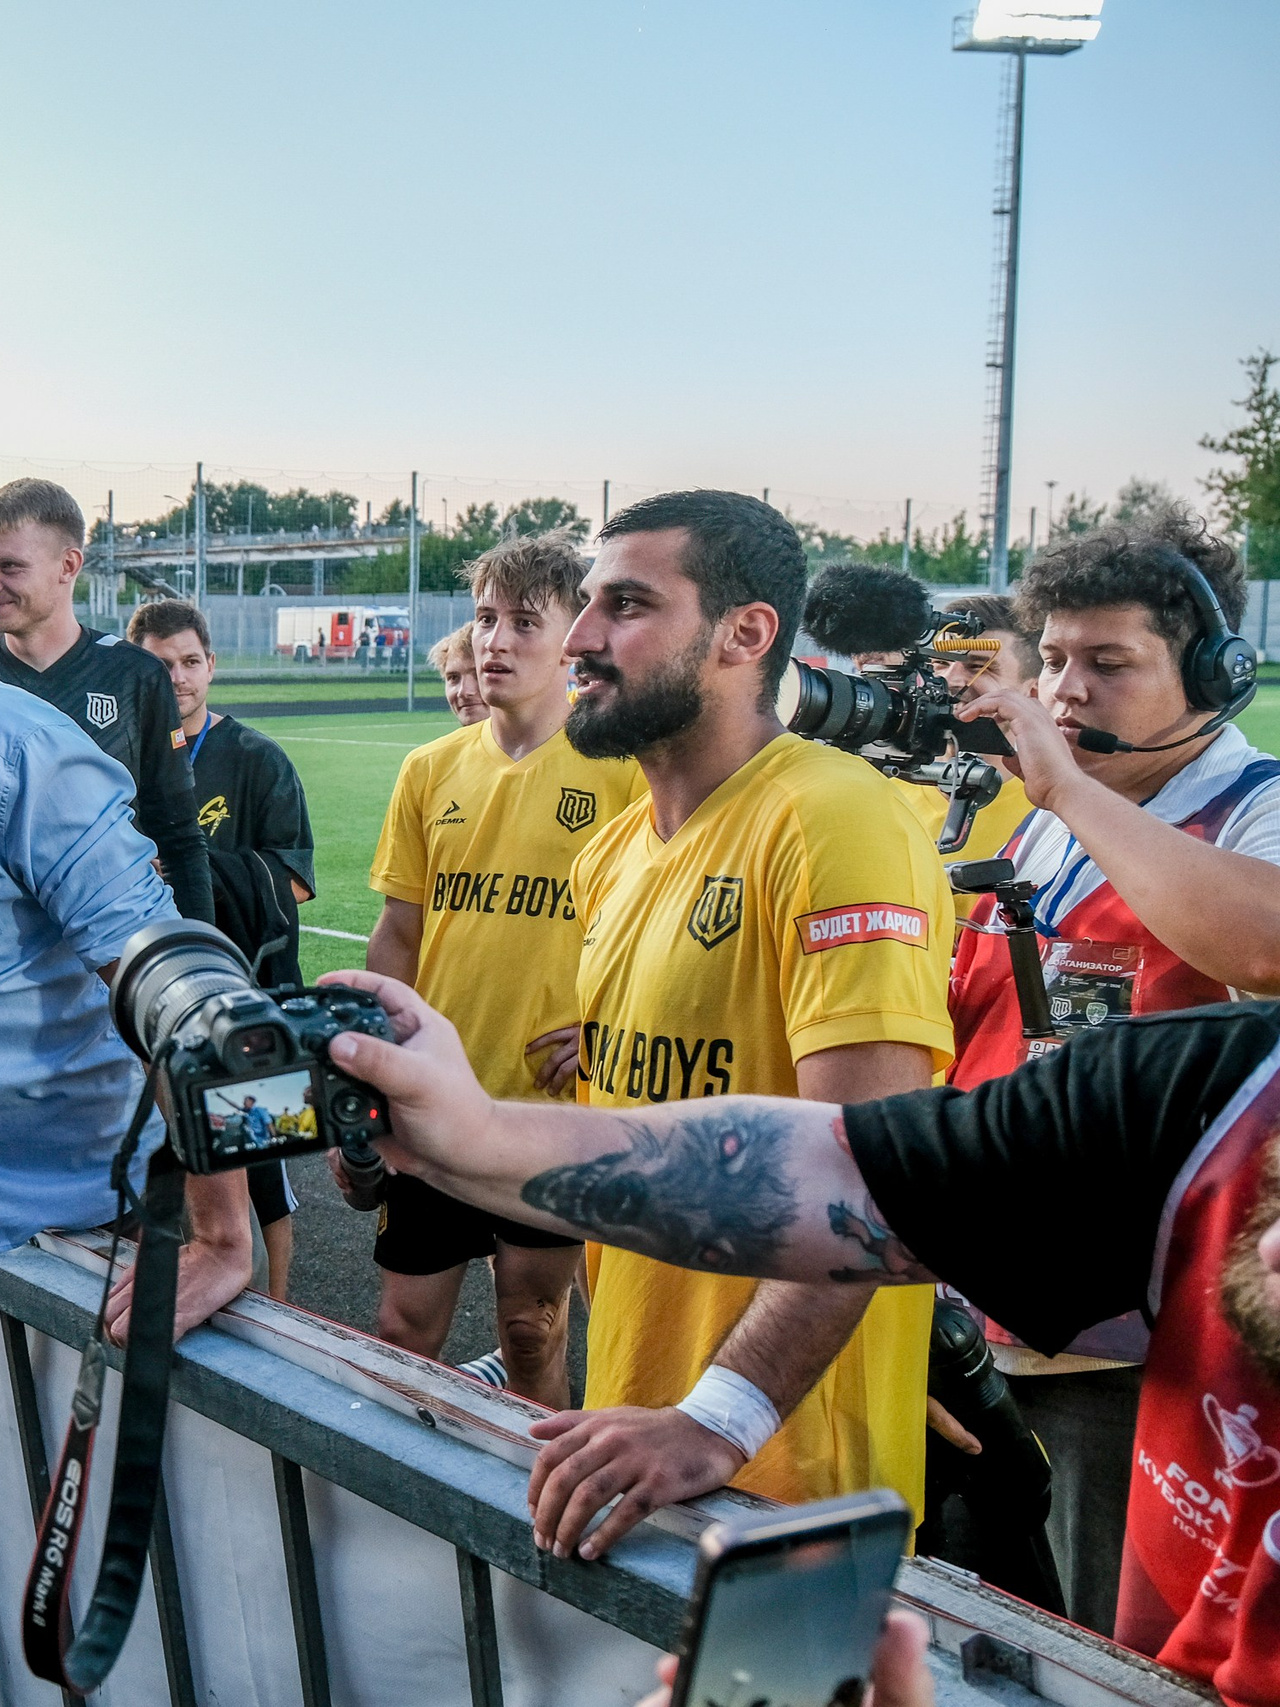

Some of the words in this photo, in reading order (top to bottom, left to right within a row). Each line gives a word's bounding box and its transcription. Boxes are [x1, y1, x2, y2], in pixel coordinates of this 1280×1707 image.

[435, 817, 467, 826] DEMIX
[505, 874, 577, 921] BOYS
[808, 912, 862, 942] БУДЕТ
[865, 910, 920, 937] ЖАРКО
[626, 1031, 733, 1103] BOYS
[56, 1457, 82, 1529] EOS
[1138, 1449, 1215, 1535] КУБОК
[44, 1526, 69, 1568] R6
[32, 1565, 55, 1613] Mark
